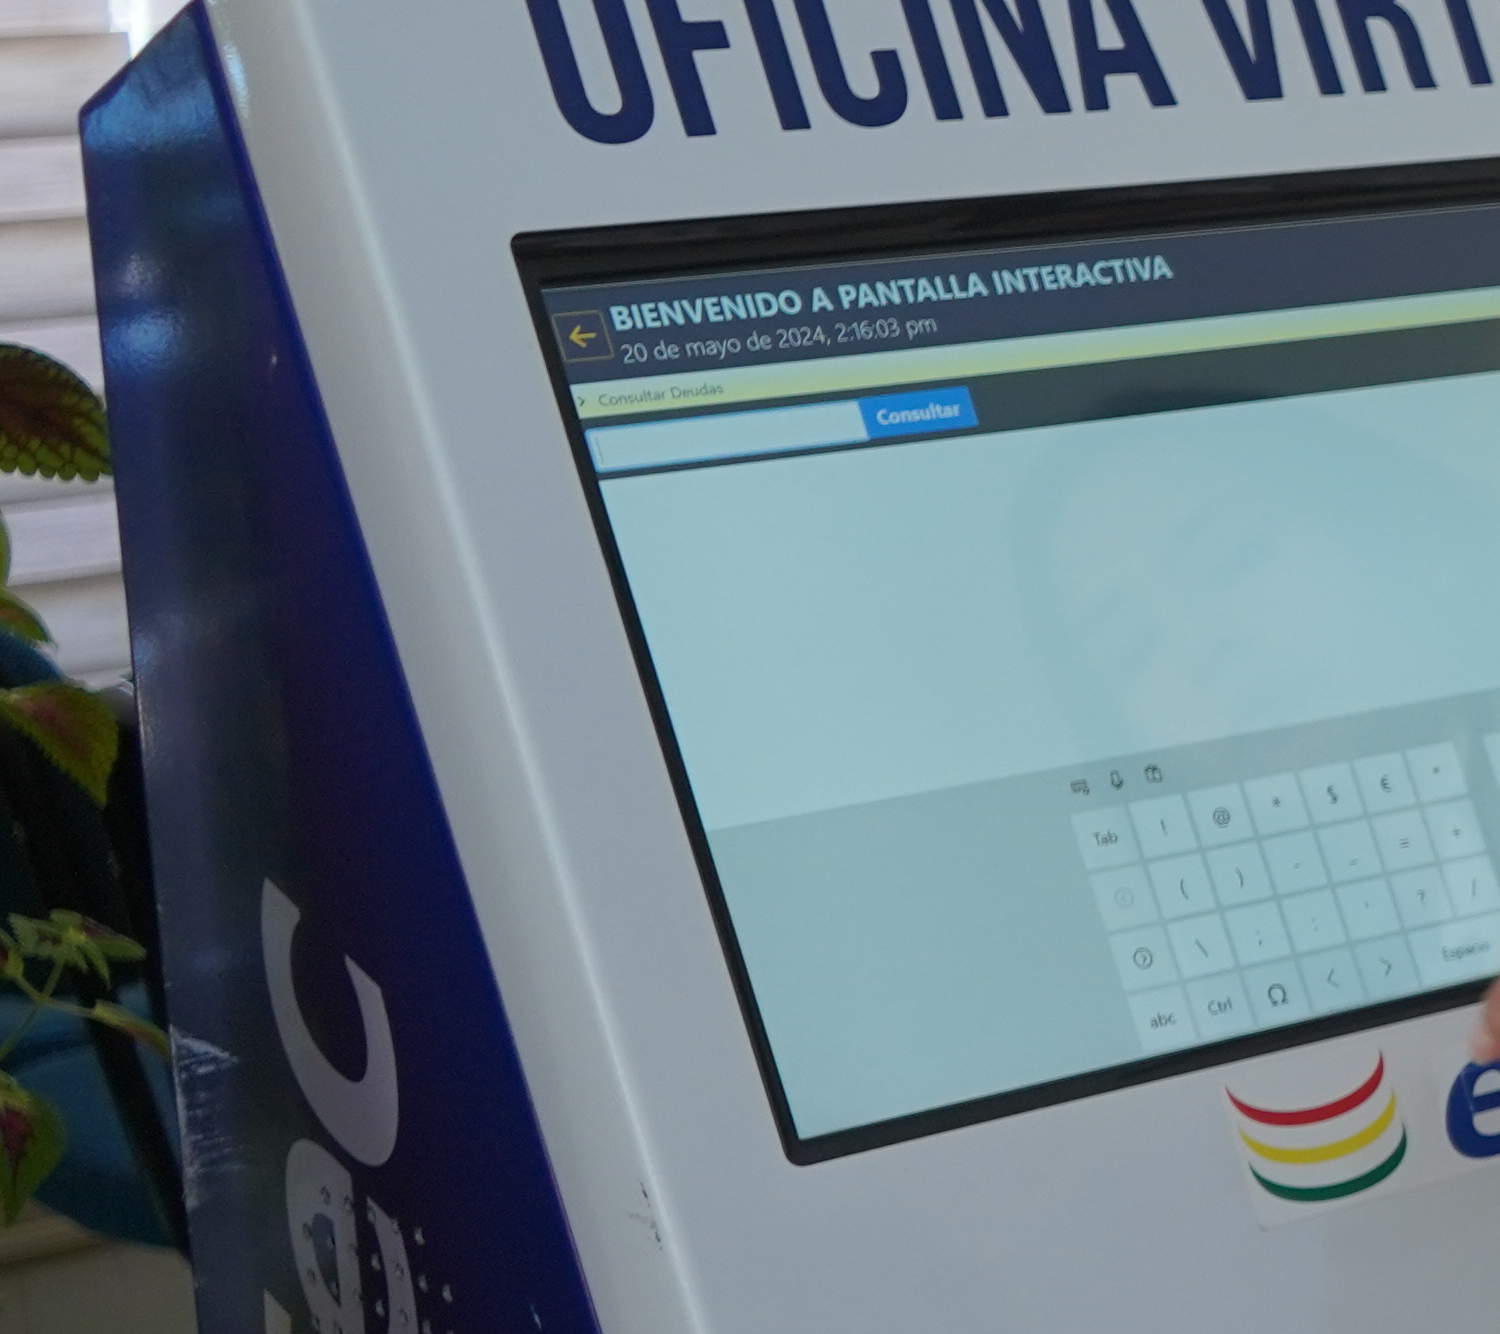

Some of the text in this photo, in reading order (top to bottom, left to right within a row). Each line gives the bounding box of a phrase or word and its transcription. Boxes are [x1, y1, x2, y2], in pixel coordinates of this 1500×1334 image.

[608, 254, 1174, 332] BIENVENIDO A PANTALLA INTERACTIVA
[620, 317, 938, 365] 20 de mayo de 2024, 2:16:03 pm
[597, 381, 725, 407] Consultar Deudas
[876, 402, 961, 427] Consultar
[1093, 830, 1119, 848] Tab
[1150, 996, 1233, 1031] abc Ctrl
